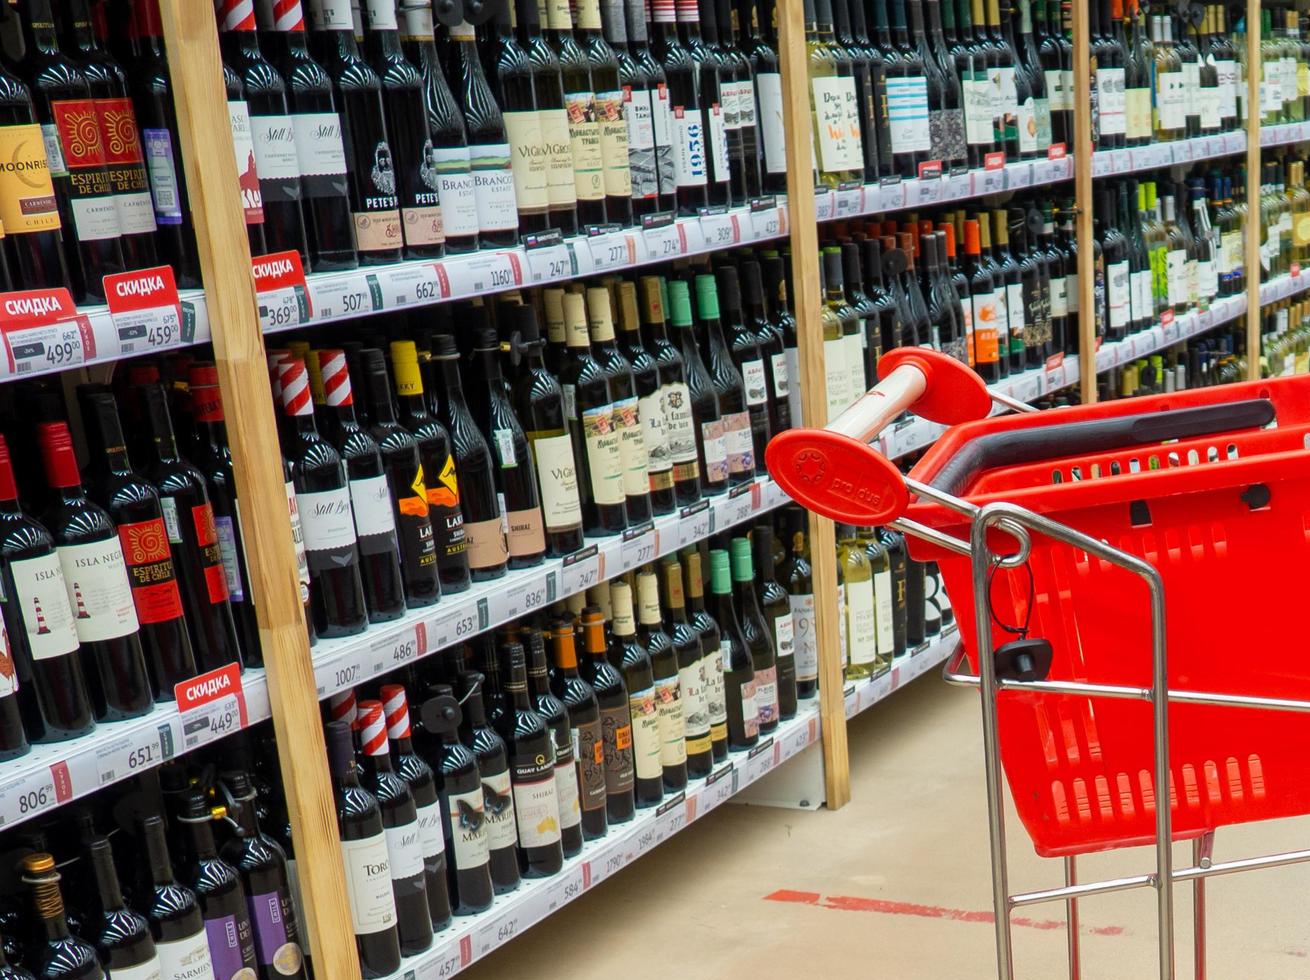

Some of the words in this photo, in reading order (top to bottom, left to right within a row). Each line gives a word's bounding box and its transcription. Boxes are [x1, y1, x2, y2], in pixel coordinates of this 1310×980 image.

[252, 259, 295, 280] СКИДКА
[549, 260, 565, 277] 247
[116, 275, 165, 297] СКИДКА
[416, 281, 435, 299] 662
[5, 297, 62, 317] СКИДКА
[342, 293, 362, 312] 507
[268, 305, 291, 326] 369
[147, 325, 172, 347] 459
[46, 342, 73, 364] 499
[75, 556, 99, 568] ISLA
[35, 569, 55, 582] ISLA
[579, 571, 593, 588] 247
[525, 590, 541, 608] 836
[456, 617, 473, 636] 653
[393, 641, 411, 662] 486
[335, 665, 356, 687] 1007
[186, 673, 231, 701] СКИДКА
[210, 712, 232, 734] 449
[128, 746, 153, 769] 651
[516, 767, 535, 775] QUAY
[19, 786, 47, 814] 806
[497, 922, 514, 941] 642
[439, 958, 455, 977] 457
